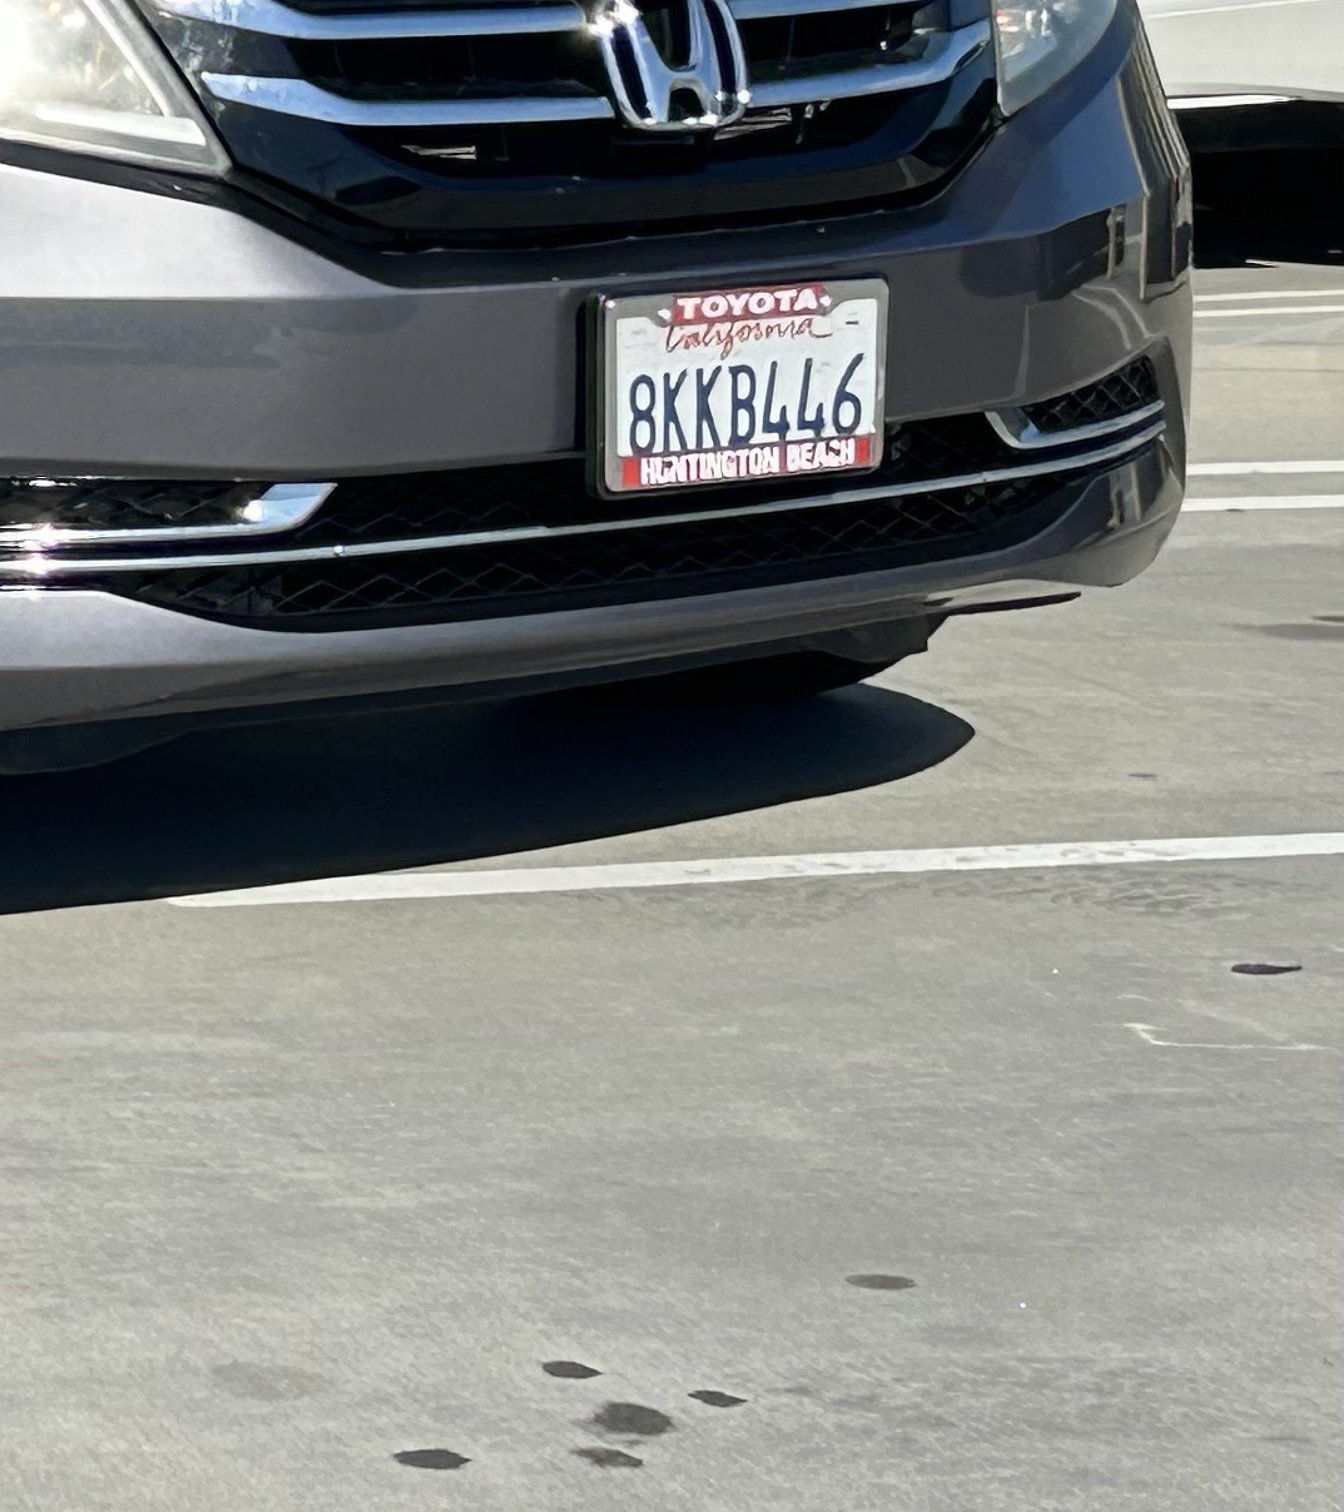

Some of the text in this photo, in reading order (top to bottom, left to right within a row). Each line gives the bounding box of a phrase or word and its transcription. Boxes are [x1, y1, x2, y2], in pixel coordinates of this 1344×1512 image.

[676, 288, 818, 320] TOYOTA
[665, 317, 833, 361] California
[629, 352, 865, 455] 8KKB446
[640, 437, 856, 486] HUNTINGTON BEACH
